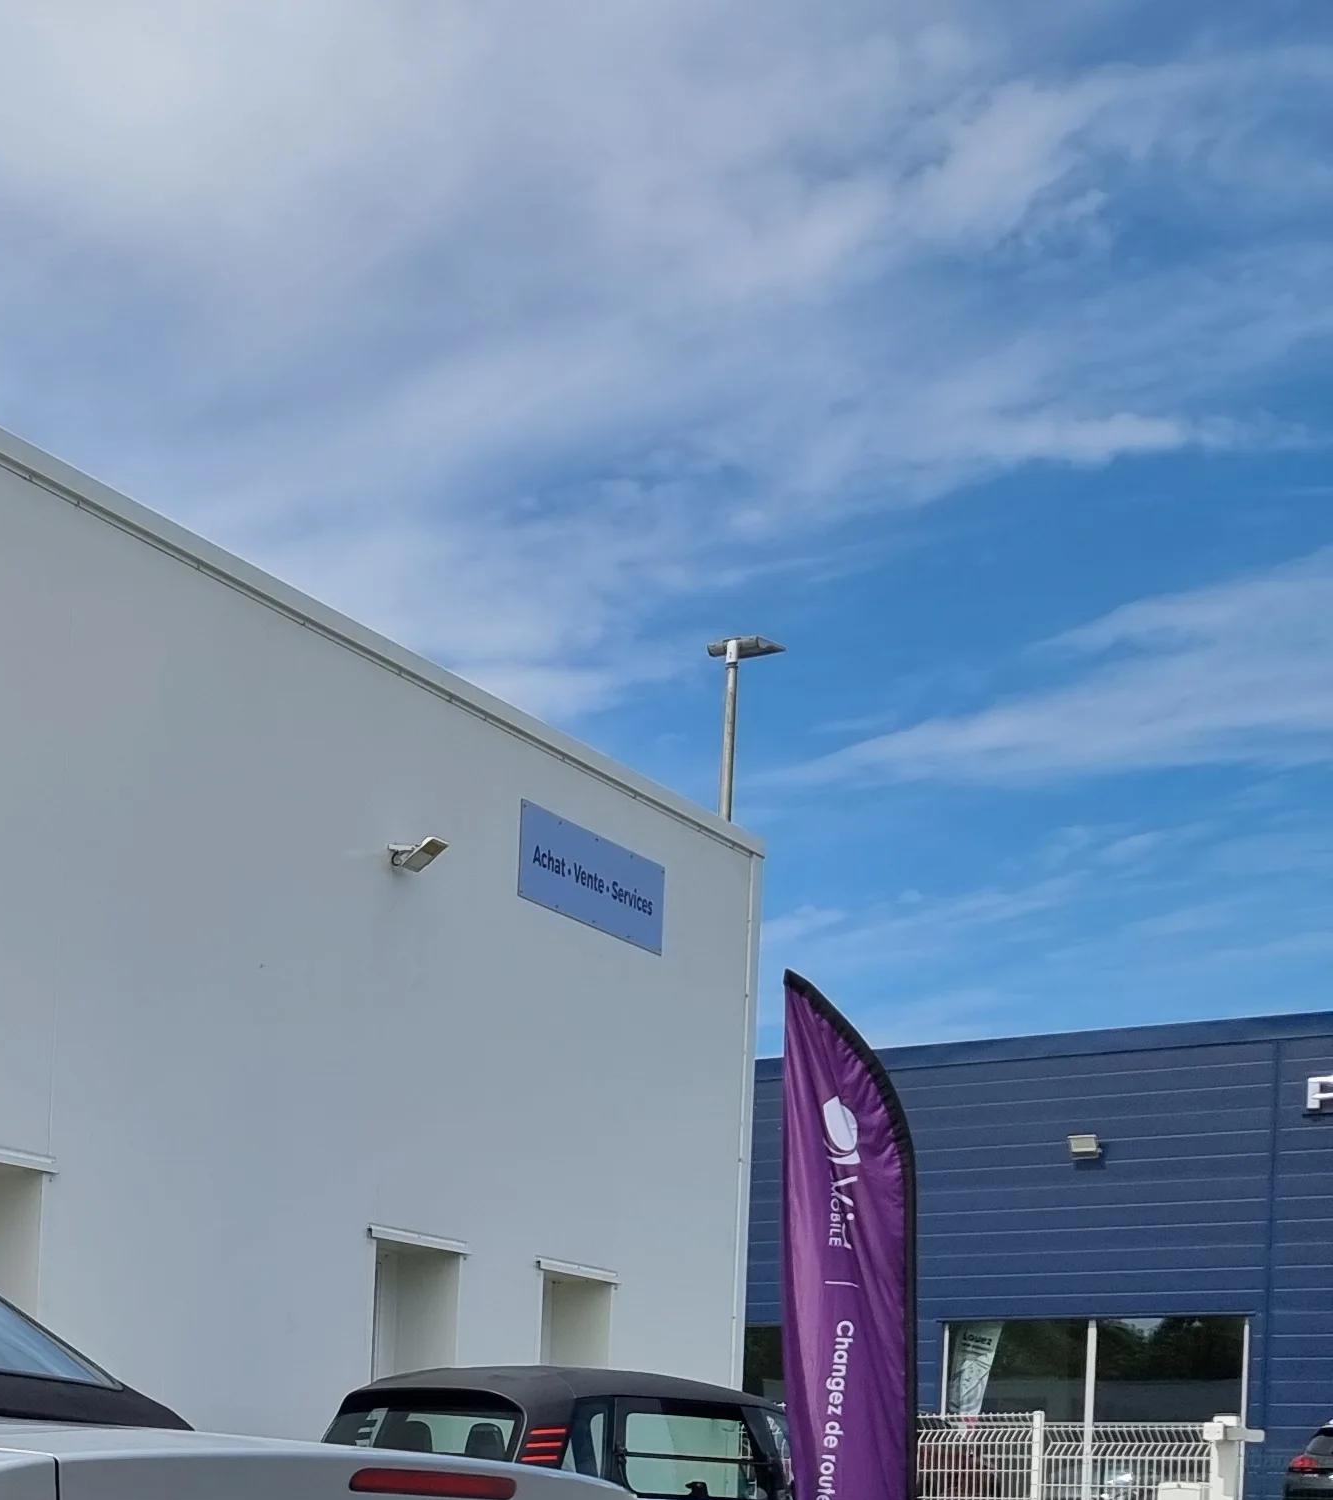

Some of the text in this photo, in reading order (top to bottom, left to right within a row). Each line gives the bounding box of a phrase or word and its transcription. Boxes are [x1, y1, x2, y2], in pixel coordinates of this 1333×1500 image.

[533, 845, 653, 916] Achat Vente Services
[826, 1320, 855, 1416] Changez
[823, 1420, 845, 1449] de
